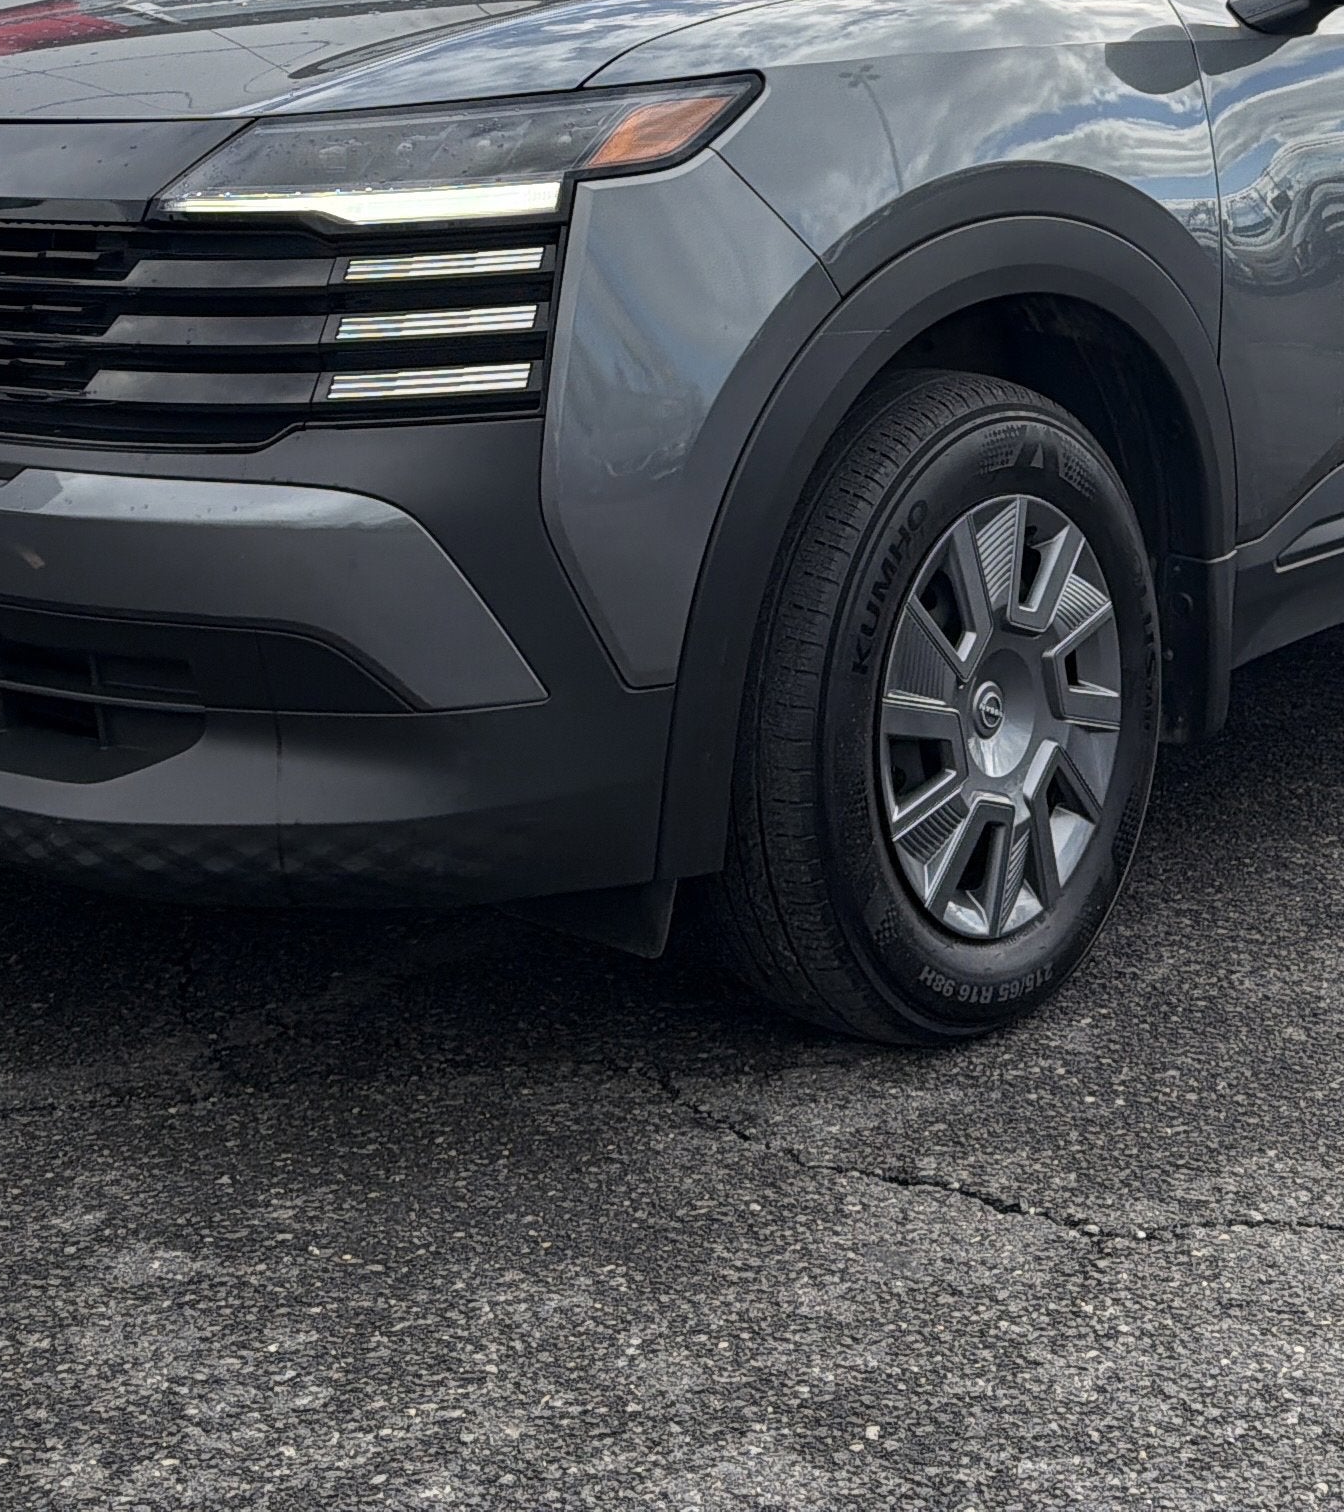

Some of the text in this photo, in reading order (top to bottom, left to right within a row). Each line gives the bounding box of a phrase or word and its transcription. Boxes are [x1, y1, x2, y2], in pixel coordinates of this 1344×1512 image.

[852, 499, 928, 675] KUMHO
[917, 961, 1055, 1005] 215/65 R16 98H
